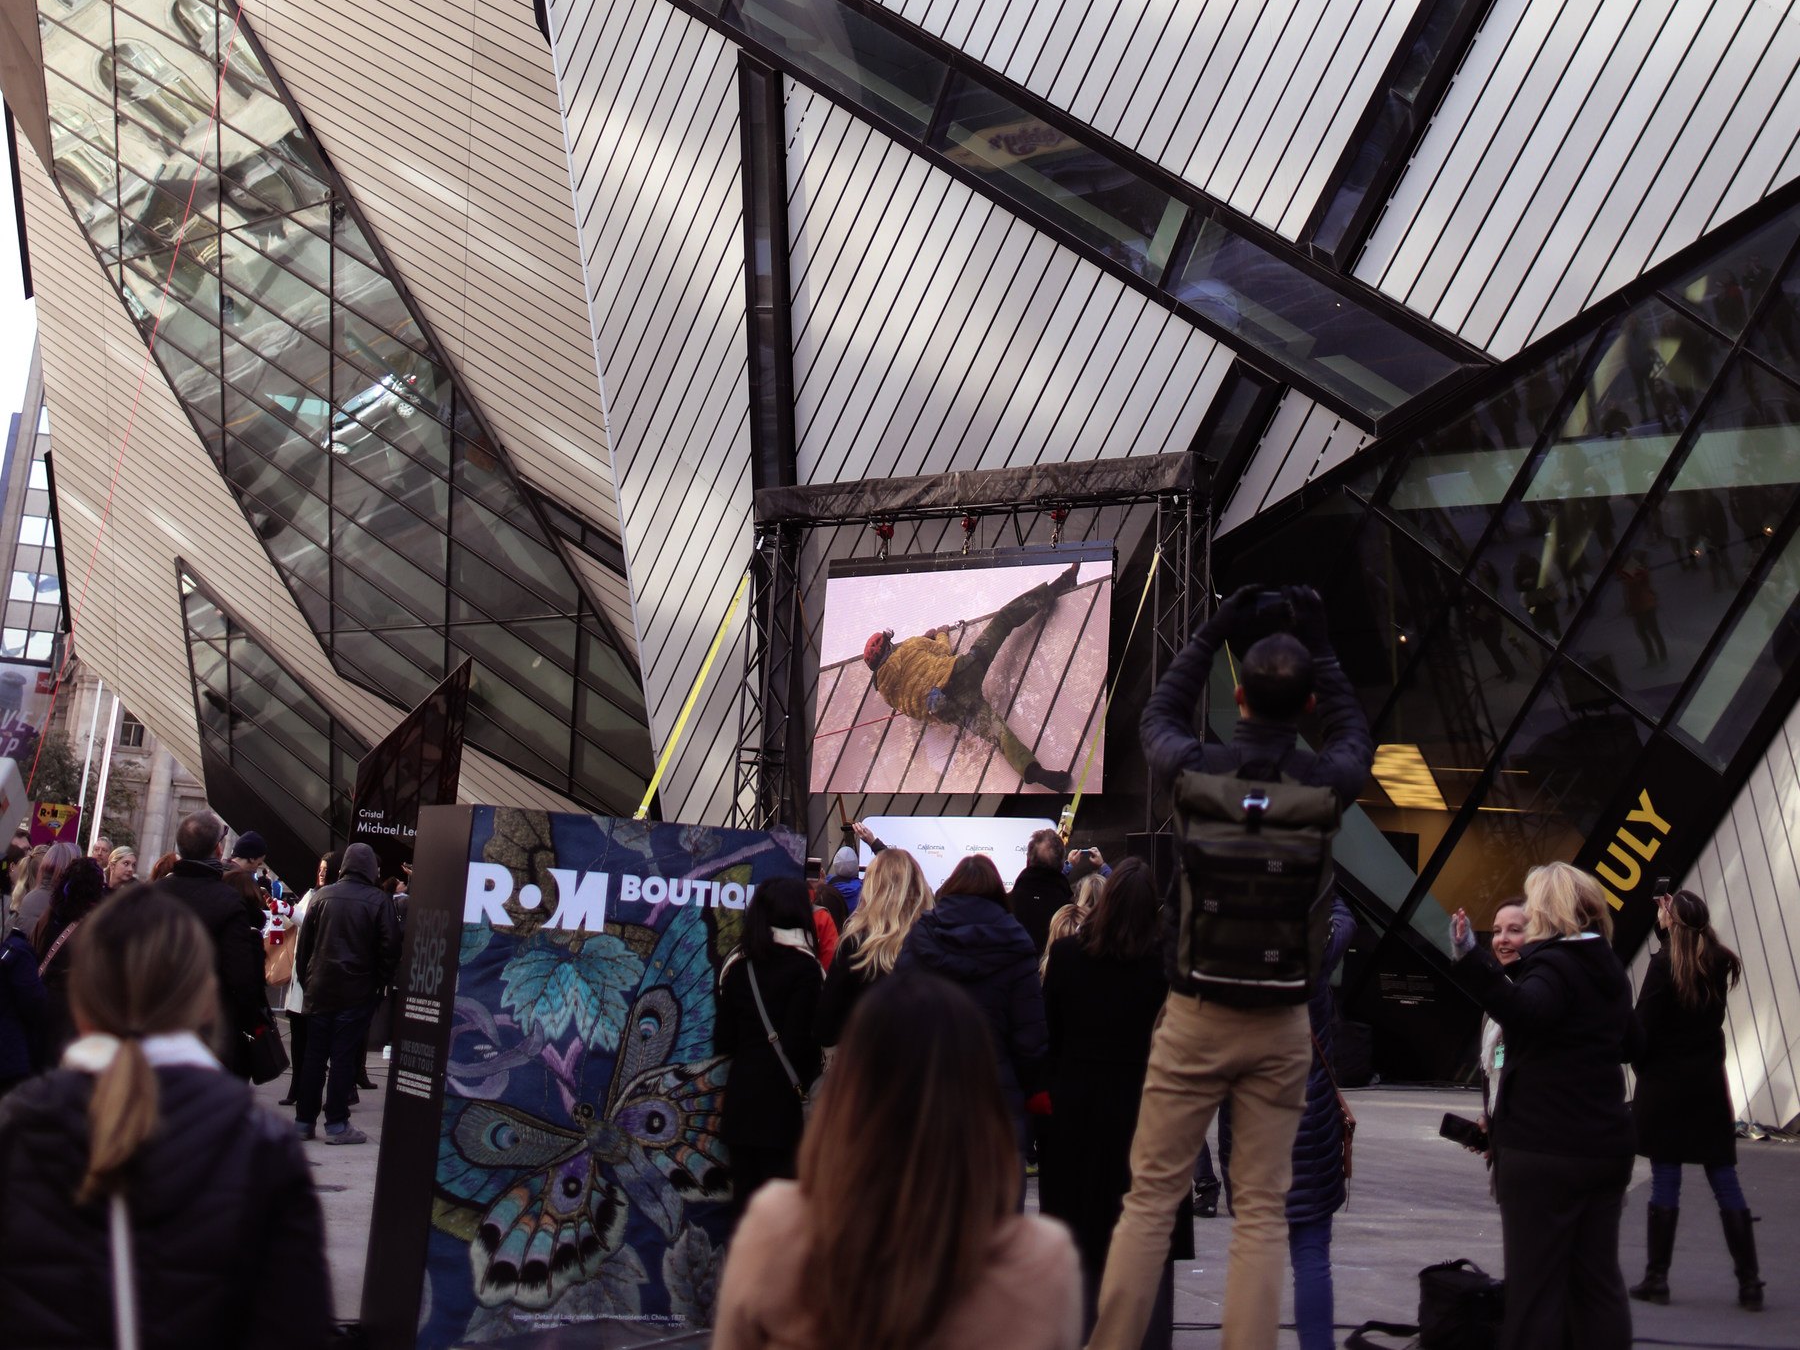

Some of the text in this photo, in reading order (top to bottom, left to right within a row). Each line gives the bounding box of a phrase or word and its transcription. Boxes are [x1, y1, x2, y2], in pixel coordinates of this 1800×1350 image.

[359, 809, 384, 819] Cristal
[357, 821, 400, 835] Michael
[412, 936, 447, 966] SHOP
[408, 963, 444, 995] SHOP
